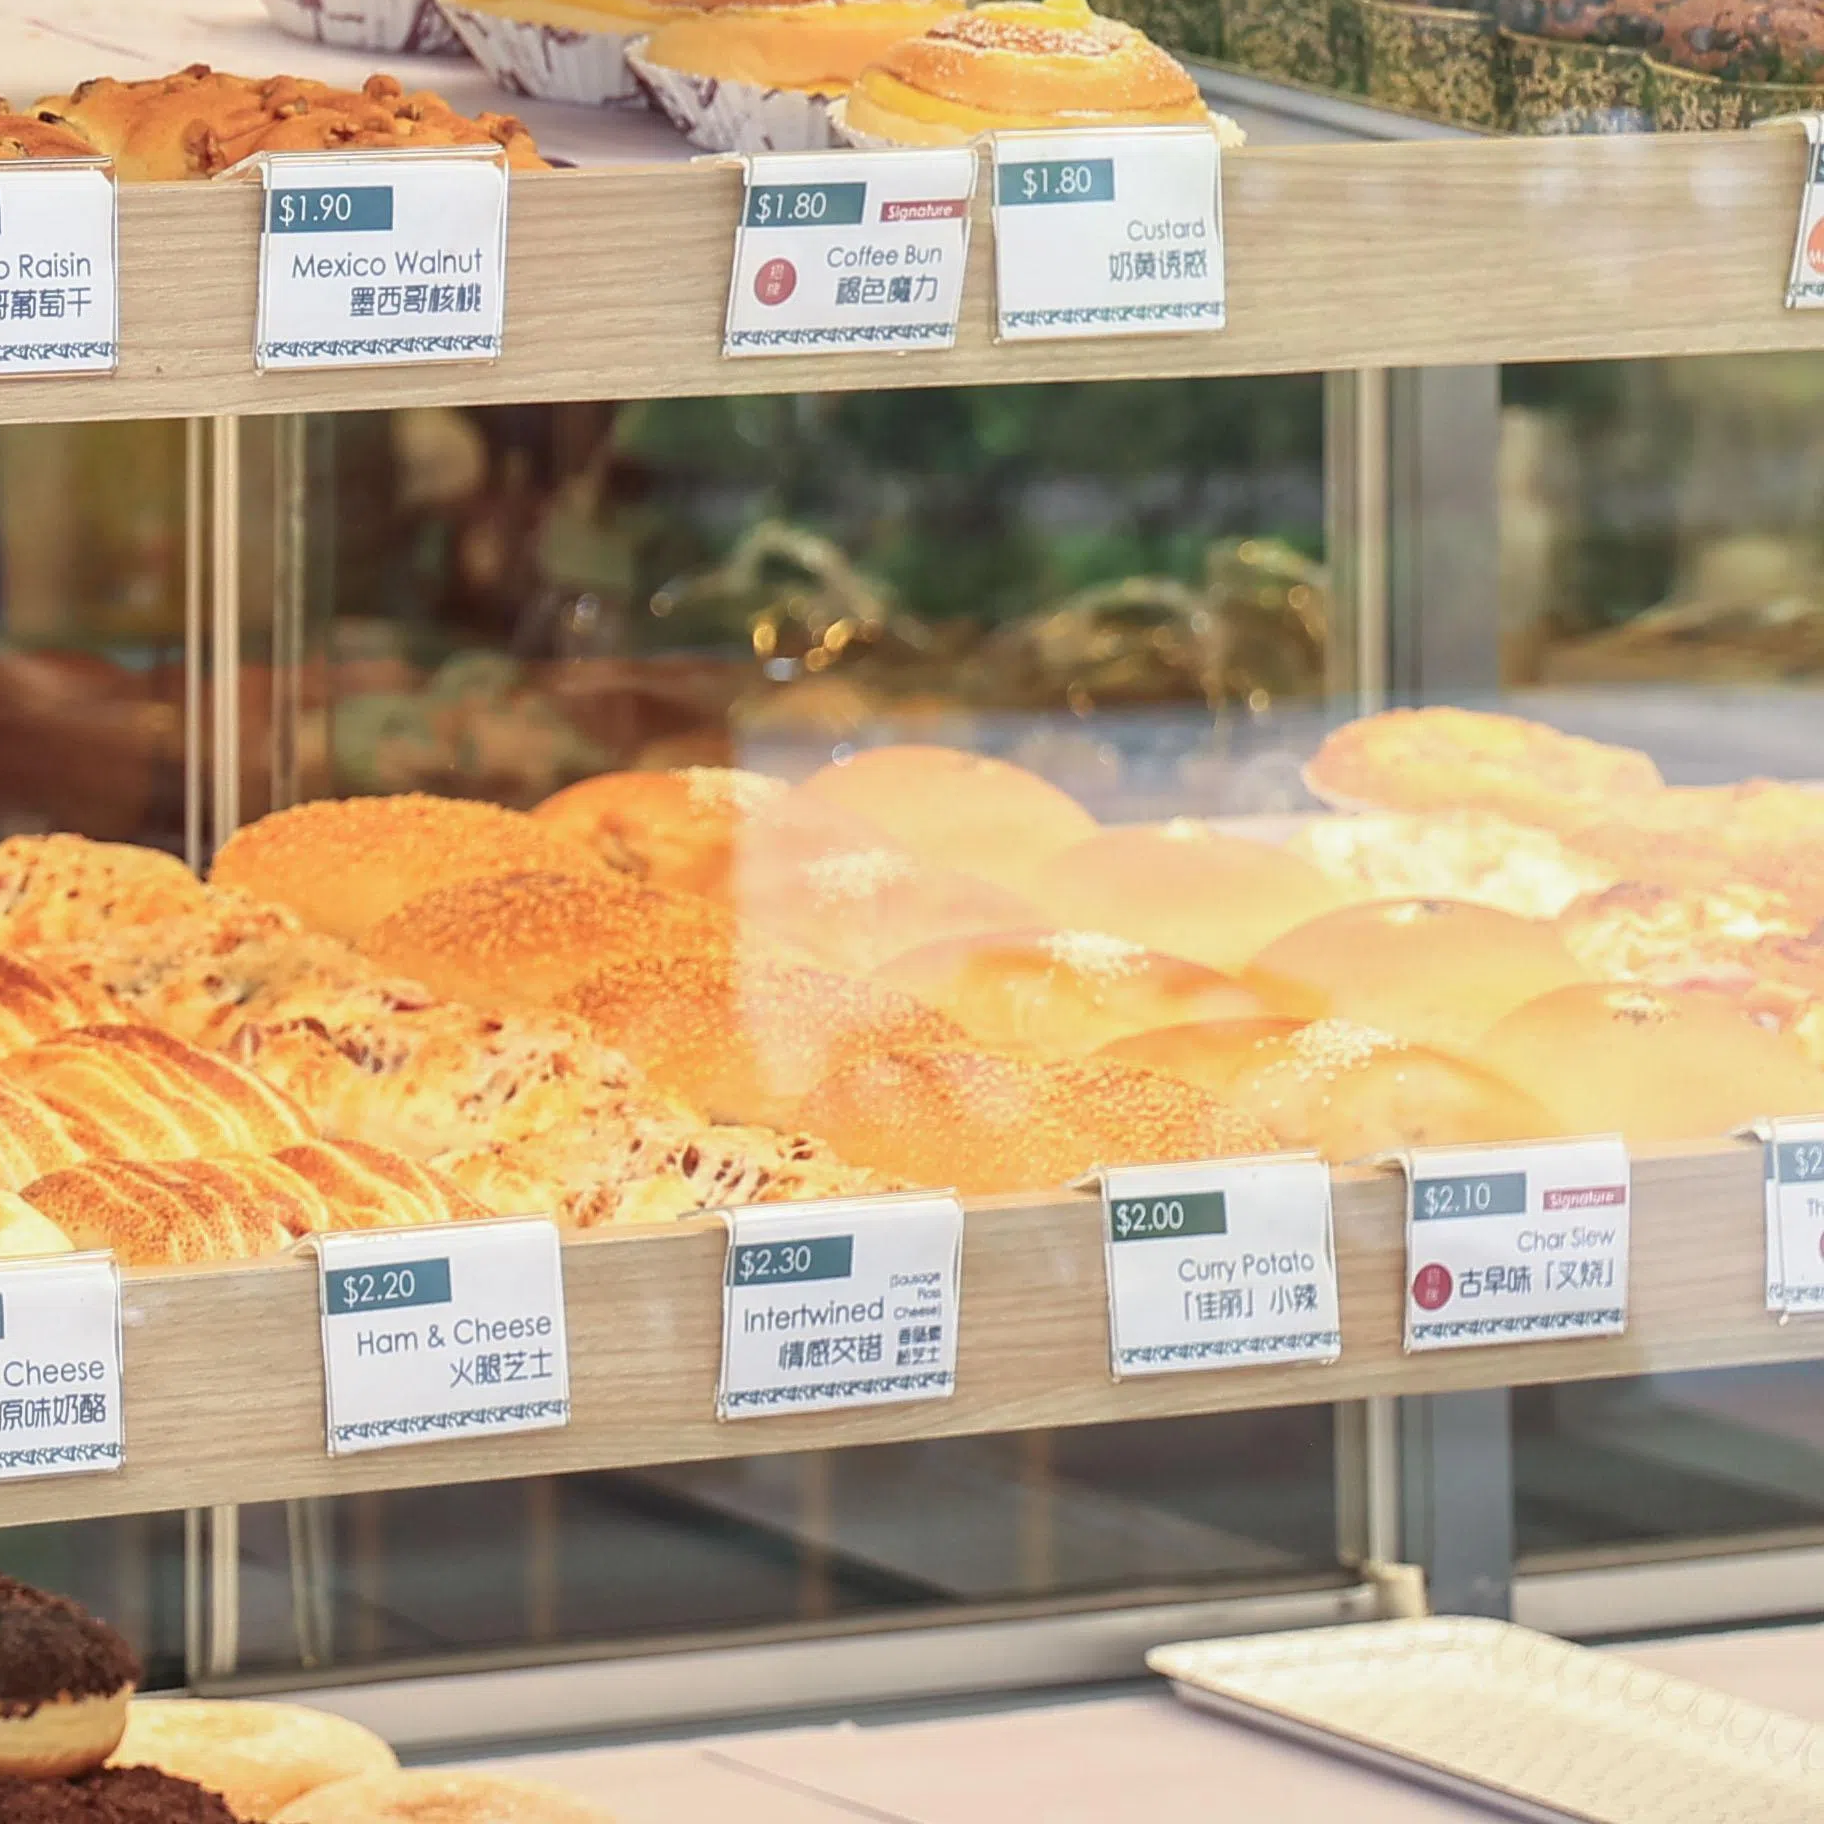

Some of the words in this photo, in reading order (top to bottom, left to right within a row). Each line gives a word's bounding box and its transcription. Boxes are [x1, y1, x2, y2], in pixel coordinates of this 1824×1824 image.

[1022, 166, 1092, 200] $1.80
[279, 193, 351, 227] $1.90
[755, 192, 827, 224] $1.80
[887, 202, 953, 220] Signature
[1127, 217, 1206, 241] Custard
[19, 252, 92, 279] Raisin
[292, 252, 386, 279] Mexico
[395, 247, 482, 275] Walnut
[827, 246, 898, 269] Coffee
[905, 244, 942, 265] Bun
[1109, 248, 1207, 282] 奶黄诱惑
[350, 283, 482, 317] 墨西哥核桃
[1424, 1182, 1491, 1217] $2.10
[1548, 1191, 1615, 1211] Signature
[1116, 1201, 1184, 1237] $2.00
[1517, 1230, 1566, 1253] Char
[1571, 1227, 1616, 1248] Siew
[739, 1246, 811, 1281] $2.30
[1178, 1258, 1236, 1283] Curry
[1243, 1250, 1315, 1277] Potato
[343, 1269, 415, 1308] $2.20
[1459, 1265, 1532, 1298] 古早味
[744, 1296, 885, 1333] Intertwined
[1269, 1283, 1318, 1314] 小辣
[357, 1330, 418, 1356] Ham
[428, 1325, 445, 1348] &
[453, 1316, 552, 1345] Cheese
[3, 1359, 105, 1387] Cheese
[450, 1348, 553, 1389] 火腿芝士
